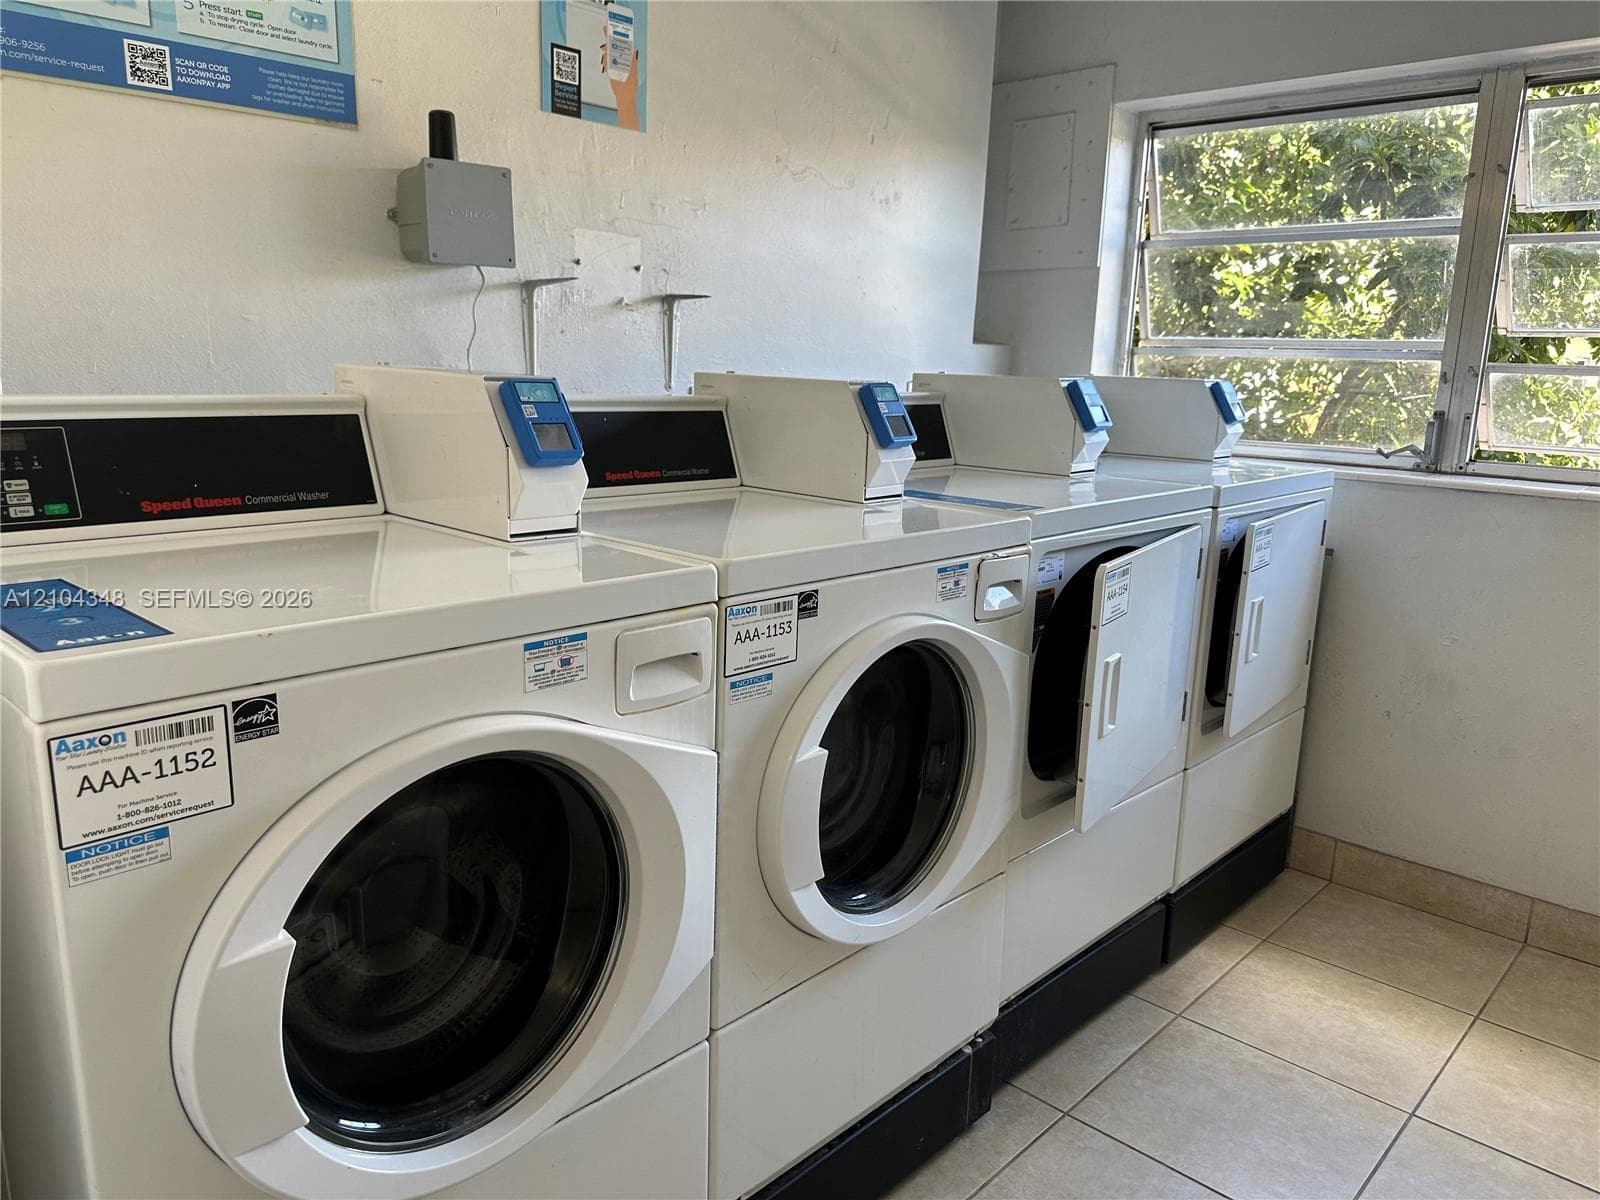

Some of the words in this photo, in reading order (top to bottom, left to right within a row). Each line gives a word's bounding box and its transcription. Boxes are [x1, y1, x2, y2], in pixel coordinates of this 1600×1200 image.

[199, 0, 222, 12] Press
[216, 14, 229, 22] stop
[230, 16, 248, 26] drying
[267, 24, 282, 32] Open
[282, 34, 296, 42] select
[298, 38, 318, 48] laundry
[175, 58, 194, 67] SCAN
[196, 62, 208, 70] QR
[208, 64, 229, 73] CODE
[176, 66, 187, 74] TO
[188, 68, 232, 82] DOWNLOAD
[176, 76, 216, 88] AAXONPAY
[216, 82, 230, 90] APP
[605, 470, 633, 480] Speed
[633, 469, 661, 478] Queen
[662, 468, 692, 477] Commercial
[140, 498, 192, 514] Speed
[193, 496, 242, 509] Queen
[245, 493, 296, 505] Commercial
[296, 490, 330, 502] Washer
[728, 606, 757, 617] Aaxon
[544, 636, 569, 646] NOTICE
[734, 620, 792, 645] AAA-1153
[736, 676, 768, 688] NOTICE
[236, 730, 260, 741] ENERGY
[262, 726, 278, 736] STAR
[55, 731, 127, 756] Aaxon
[66, 762, 86, 770] Please
[113, 751, 139, 760] machine
[149, 746, 166, 754] when
[166, 740, 193, 750] reporting
[76, 748, 217, 798] AAA-1152
[129, 798, 155, 806] Machine
[156, 791, 178, 800] Service
[116, 798, 182, 820] 1-800-826-1012
[82, 800, 215, 839] www.aaxon.com/servicerequest
[81, 832, 156, 858] NOTICE
[70, 860, 92, 870] DOOR
[92, 856, 110, 864] LOCK
[112, 850, 130, 860] LIGHT
[132, 846, 146, 854] must
[71, 868, 91, 876] before
[92, 860, 122, 871] attempting
[130, 852, 144, 861] open
[98, 868, 114, 876] push
[114, 863, 128, 871] door
[148, 854, 160, 862] pull
